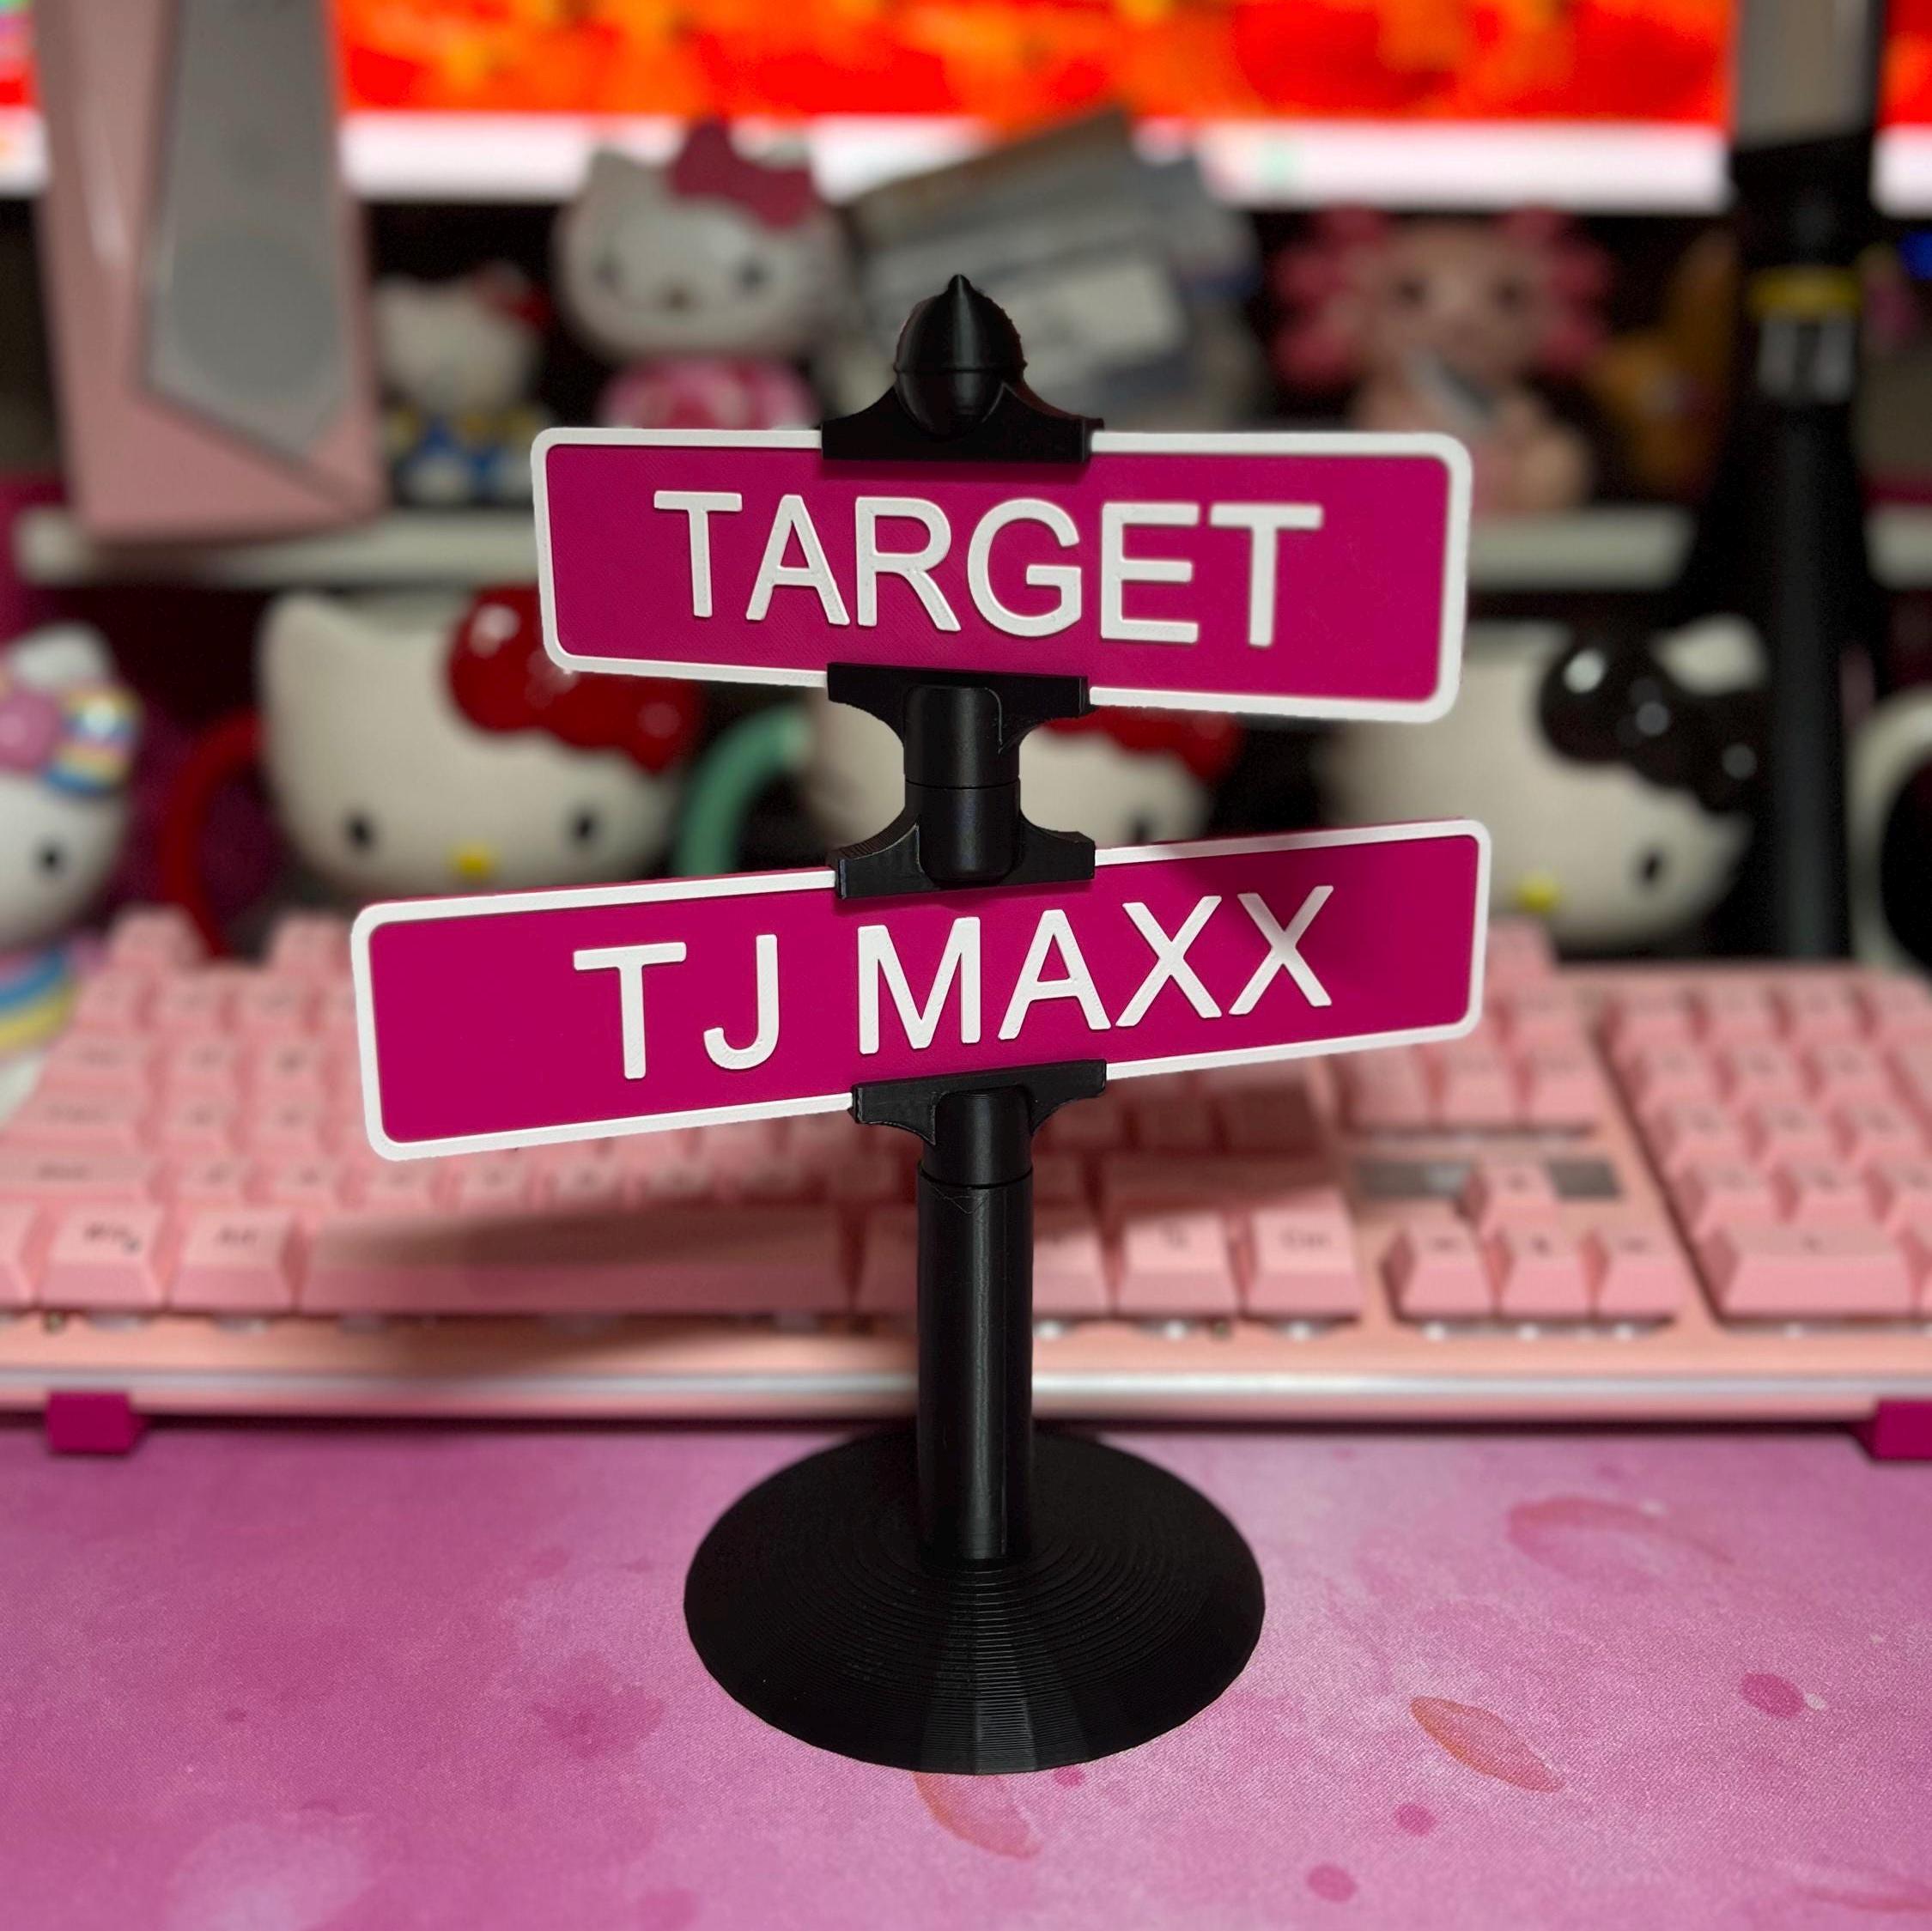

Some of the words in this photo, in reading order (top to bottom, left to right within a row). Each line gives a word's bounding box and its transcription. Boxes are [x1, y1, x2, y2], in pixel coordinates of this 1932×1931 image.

[653, 489, 1323, 648] TARGET
[573, 932, 781, 1080] TJ
[856, 884, 1334, 1055] MAXX
